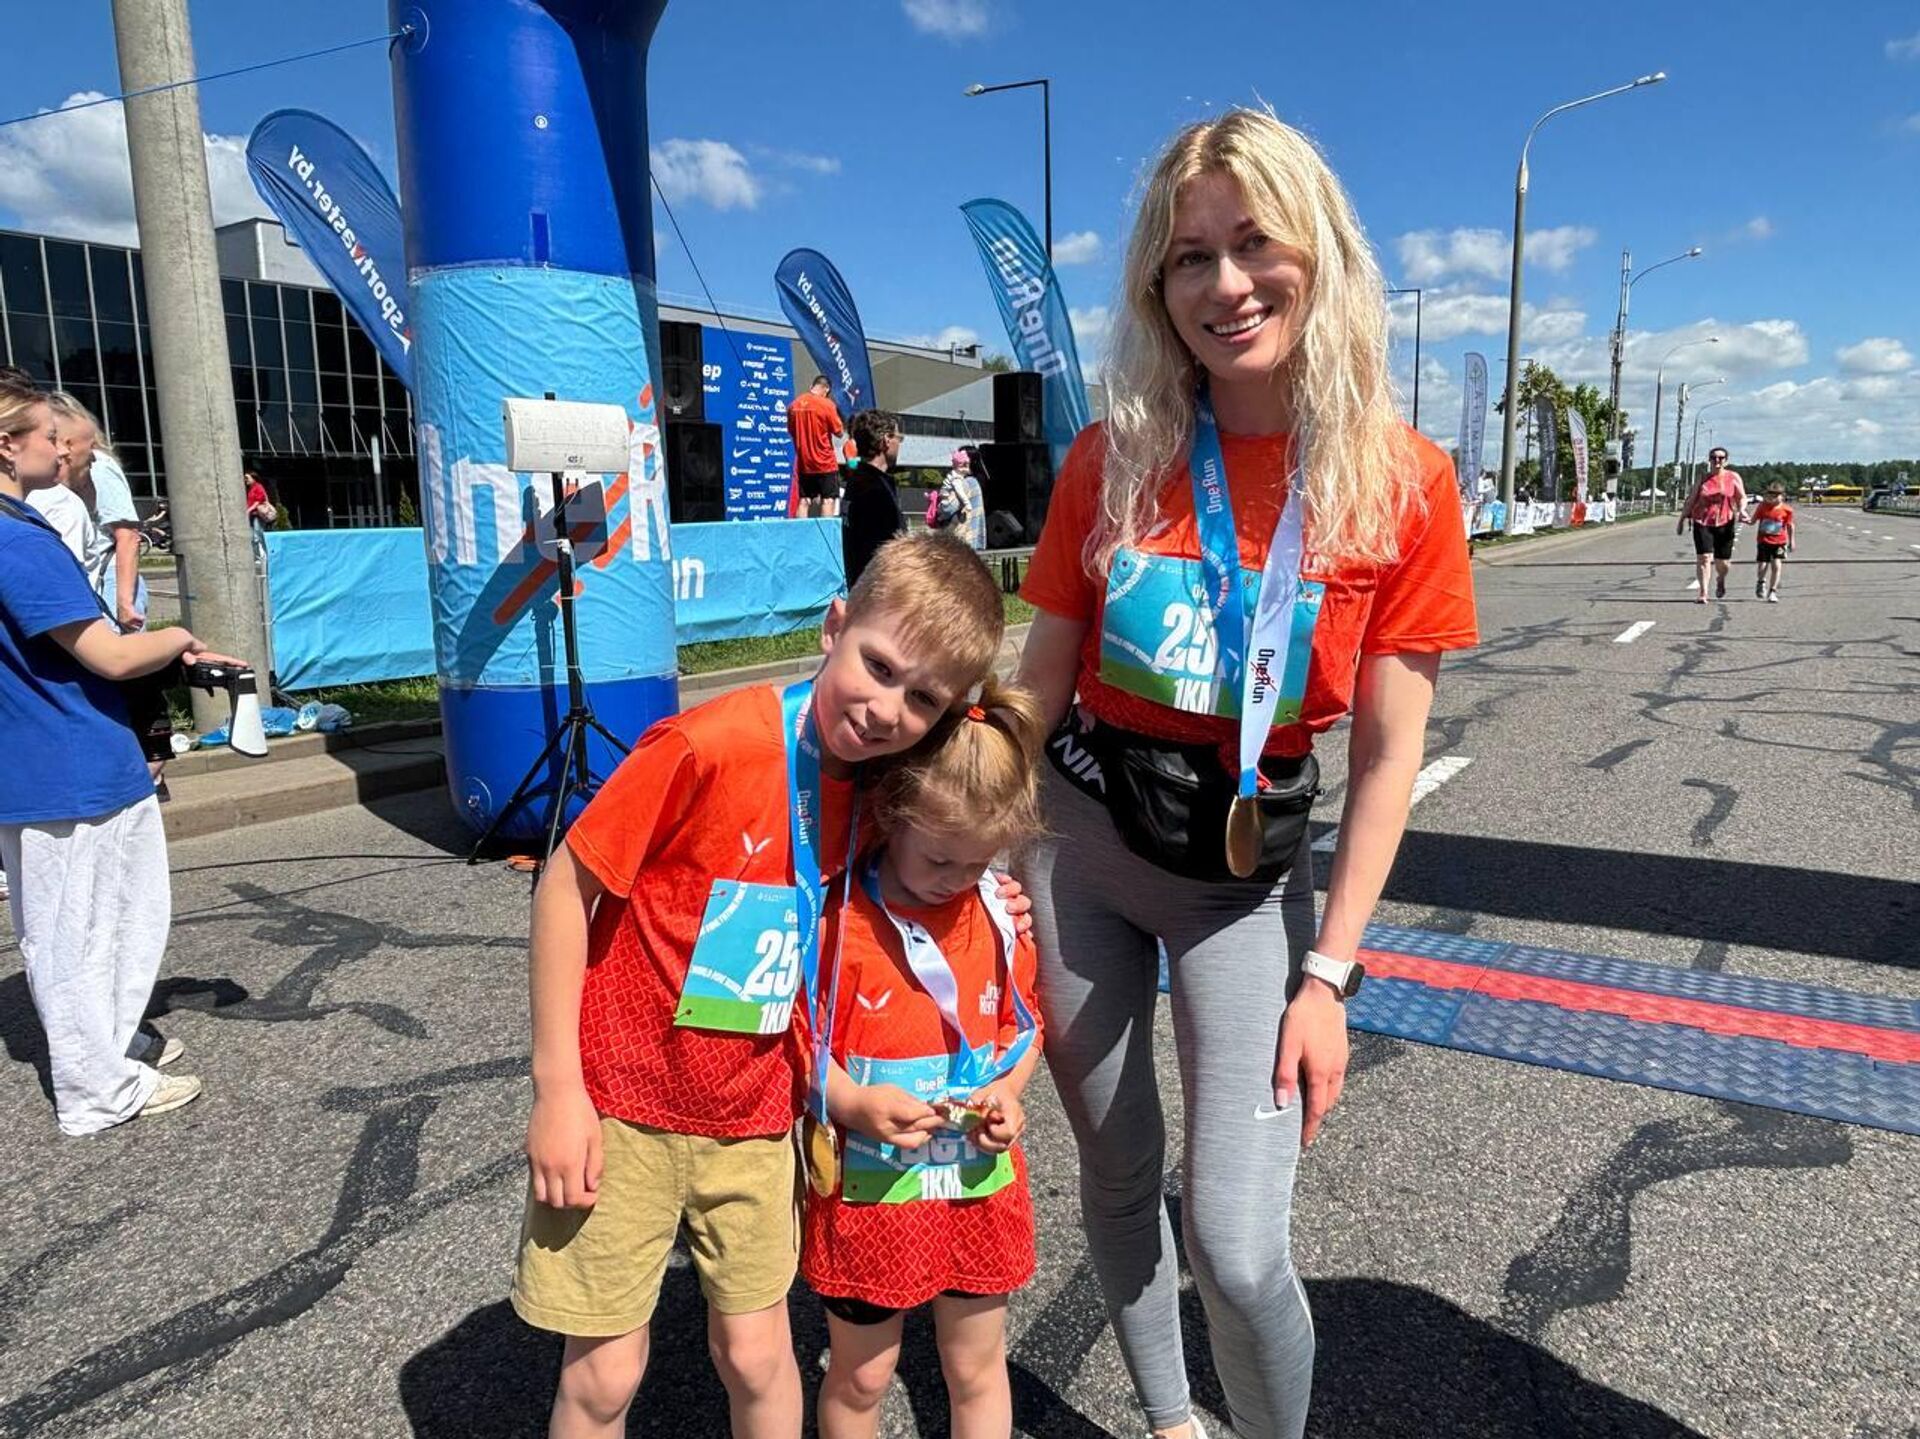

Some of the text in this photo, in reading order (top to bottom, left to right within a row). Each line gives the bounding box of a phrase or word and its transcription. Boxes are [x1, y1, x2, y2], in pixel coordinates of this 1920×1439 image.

[1155, 602, 1225, 678] 25
[1252, 648, 1276, 704] OneRun
[920, 1163, 963, 1200] 1KM
